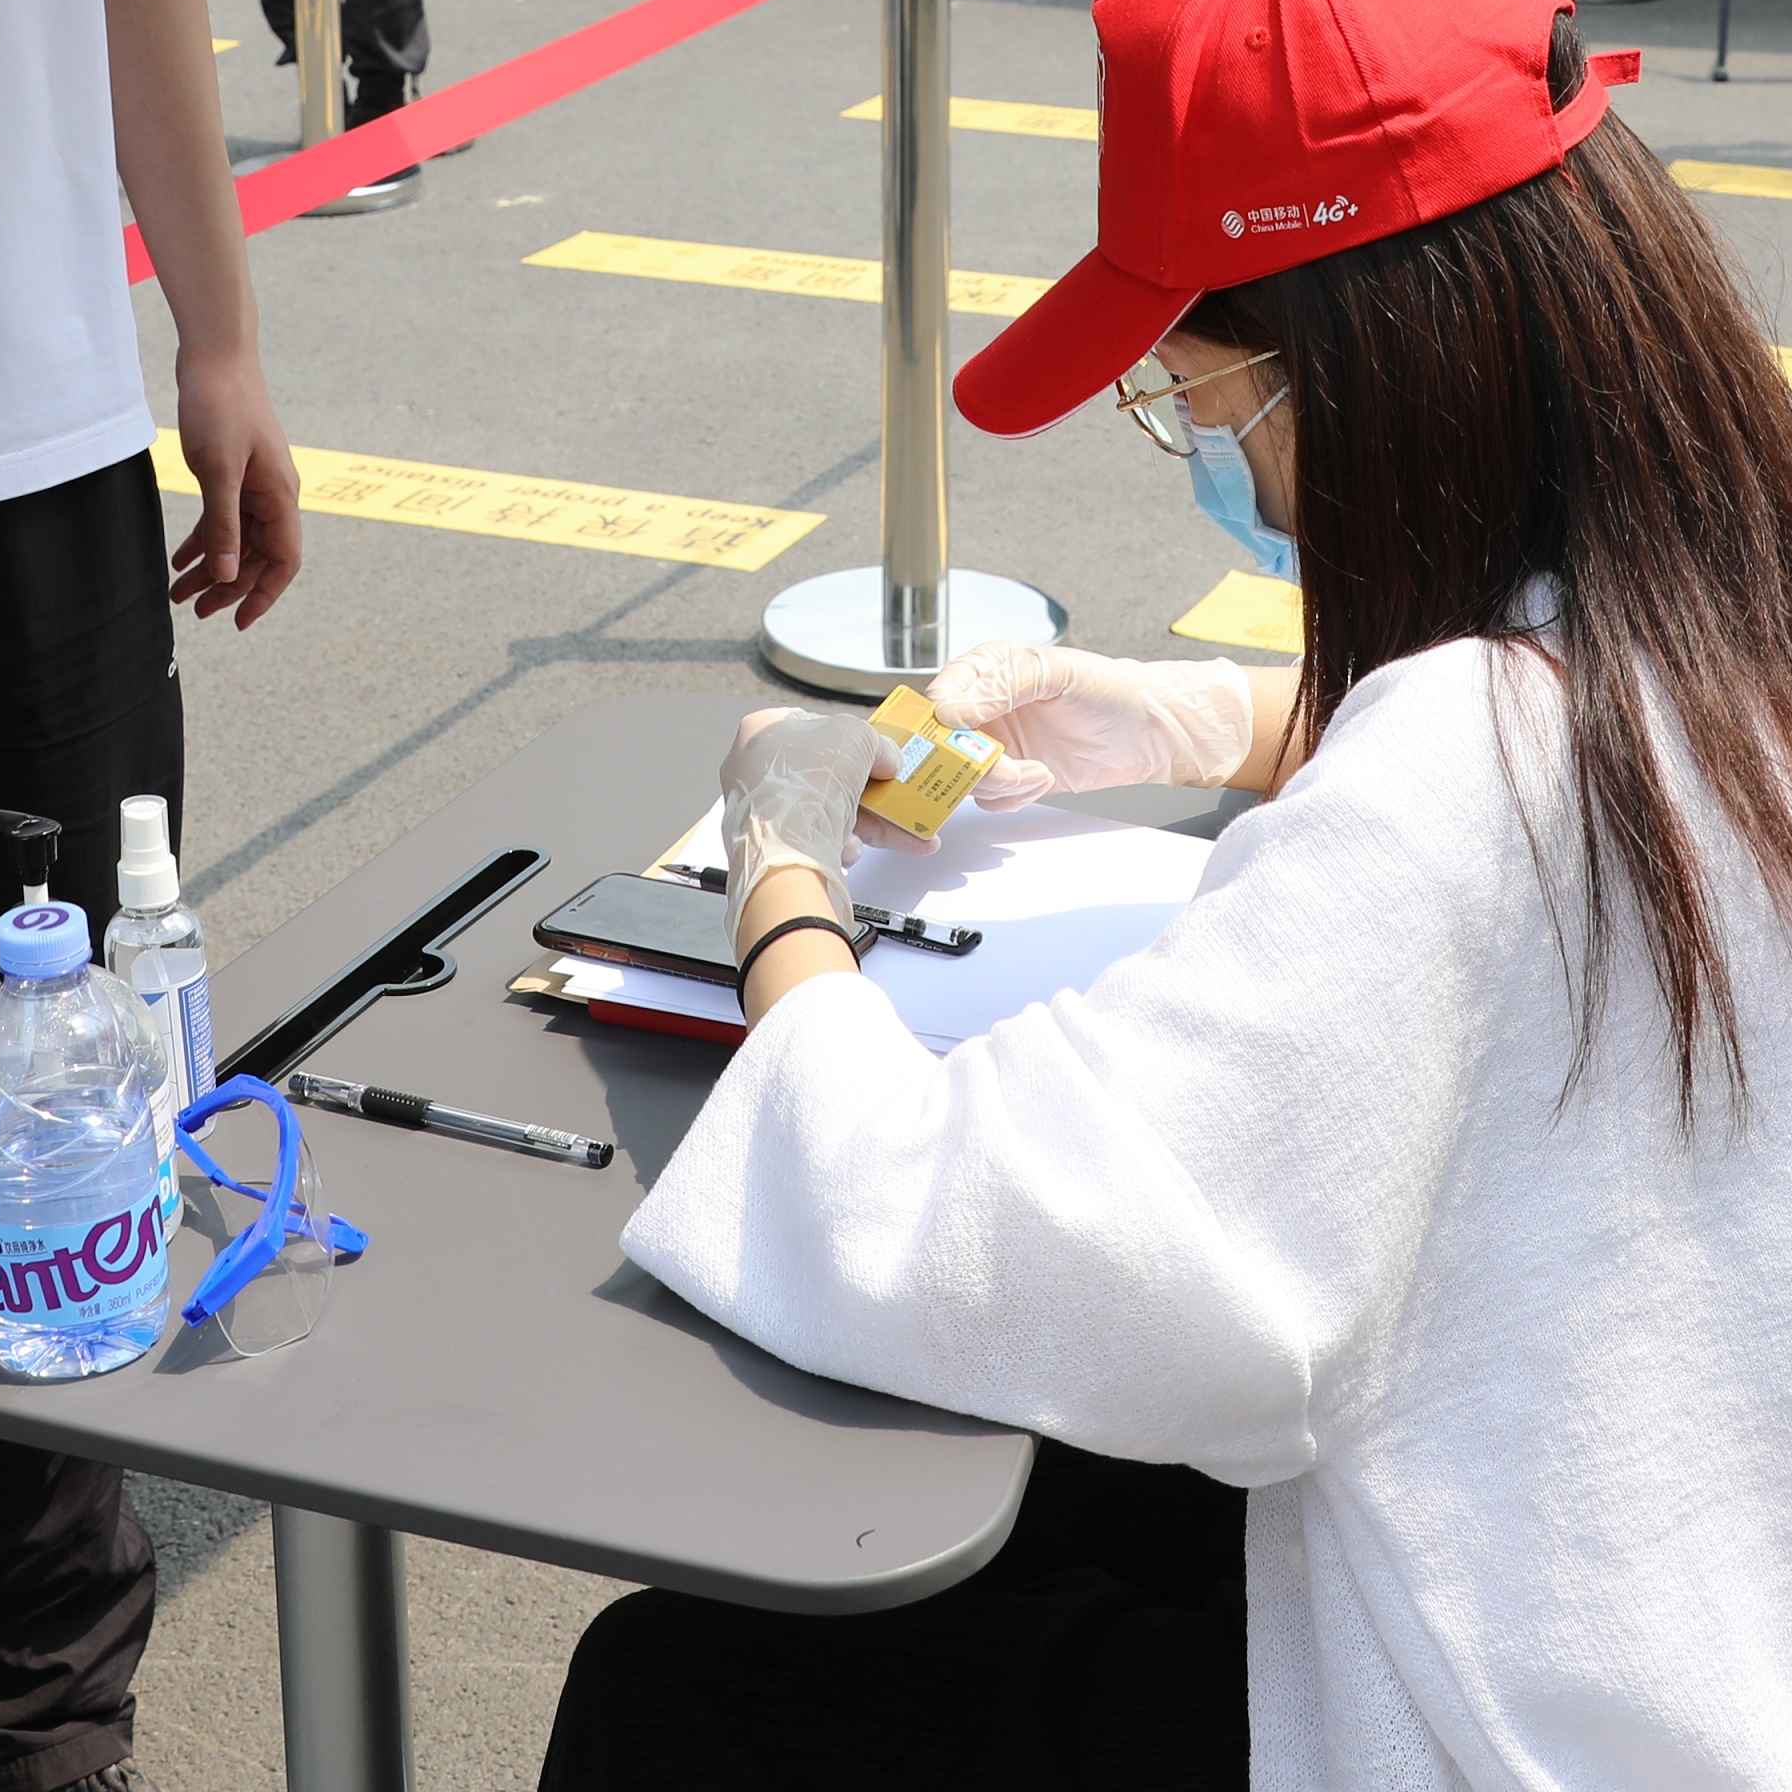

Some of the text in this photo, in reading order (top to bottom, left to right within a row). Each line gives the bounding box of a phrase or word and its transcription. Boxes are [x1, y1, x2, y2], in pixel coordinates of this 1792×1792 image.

[1247, 204, 1300, 224] 中国移动
[1250, 220, 1303, 234] China Mobile
[347, 465, 776, 531] Keep a proper distance
[302, 476, 749, 554] 请保持间距
[107, 1291, 132, 1312] 360ml
